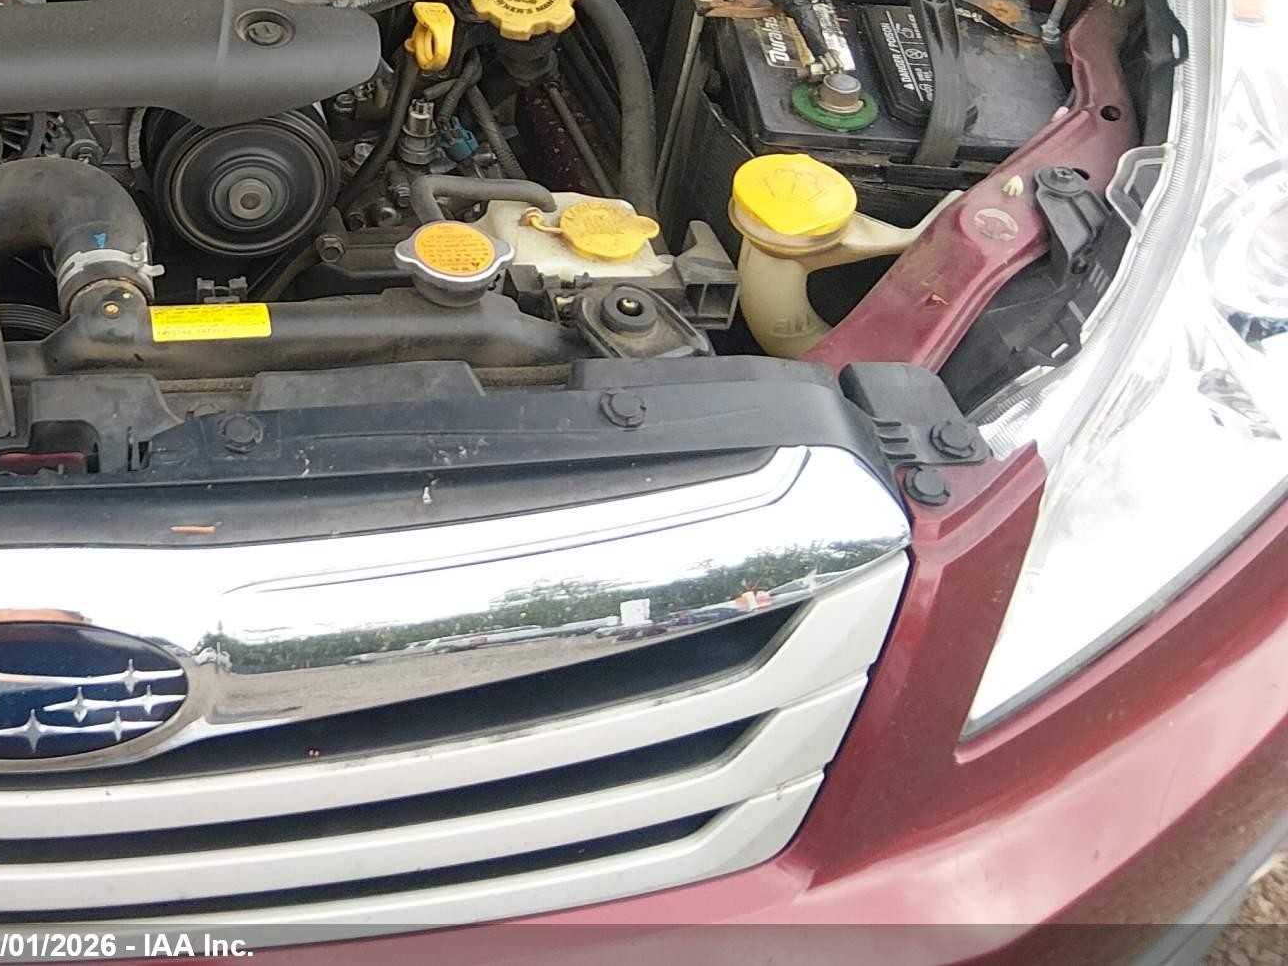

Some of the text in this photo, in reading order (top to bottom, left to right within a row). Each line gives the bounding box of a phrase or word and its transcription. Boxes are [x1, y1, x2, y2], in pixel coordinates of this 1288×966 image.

[761, 16, 791, 63] Duralas
[879, 22, 899, 48] POISON
[892, 54, 912, 83] DANGER
